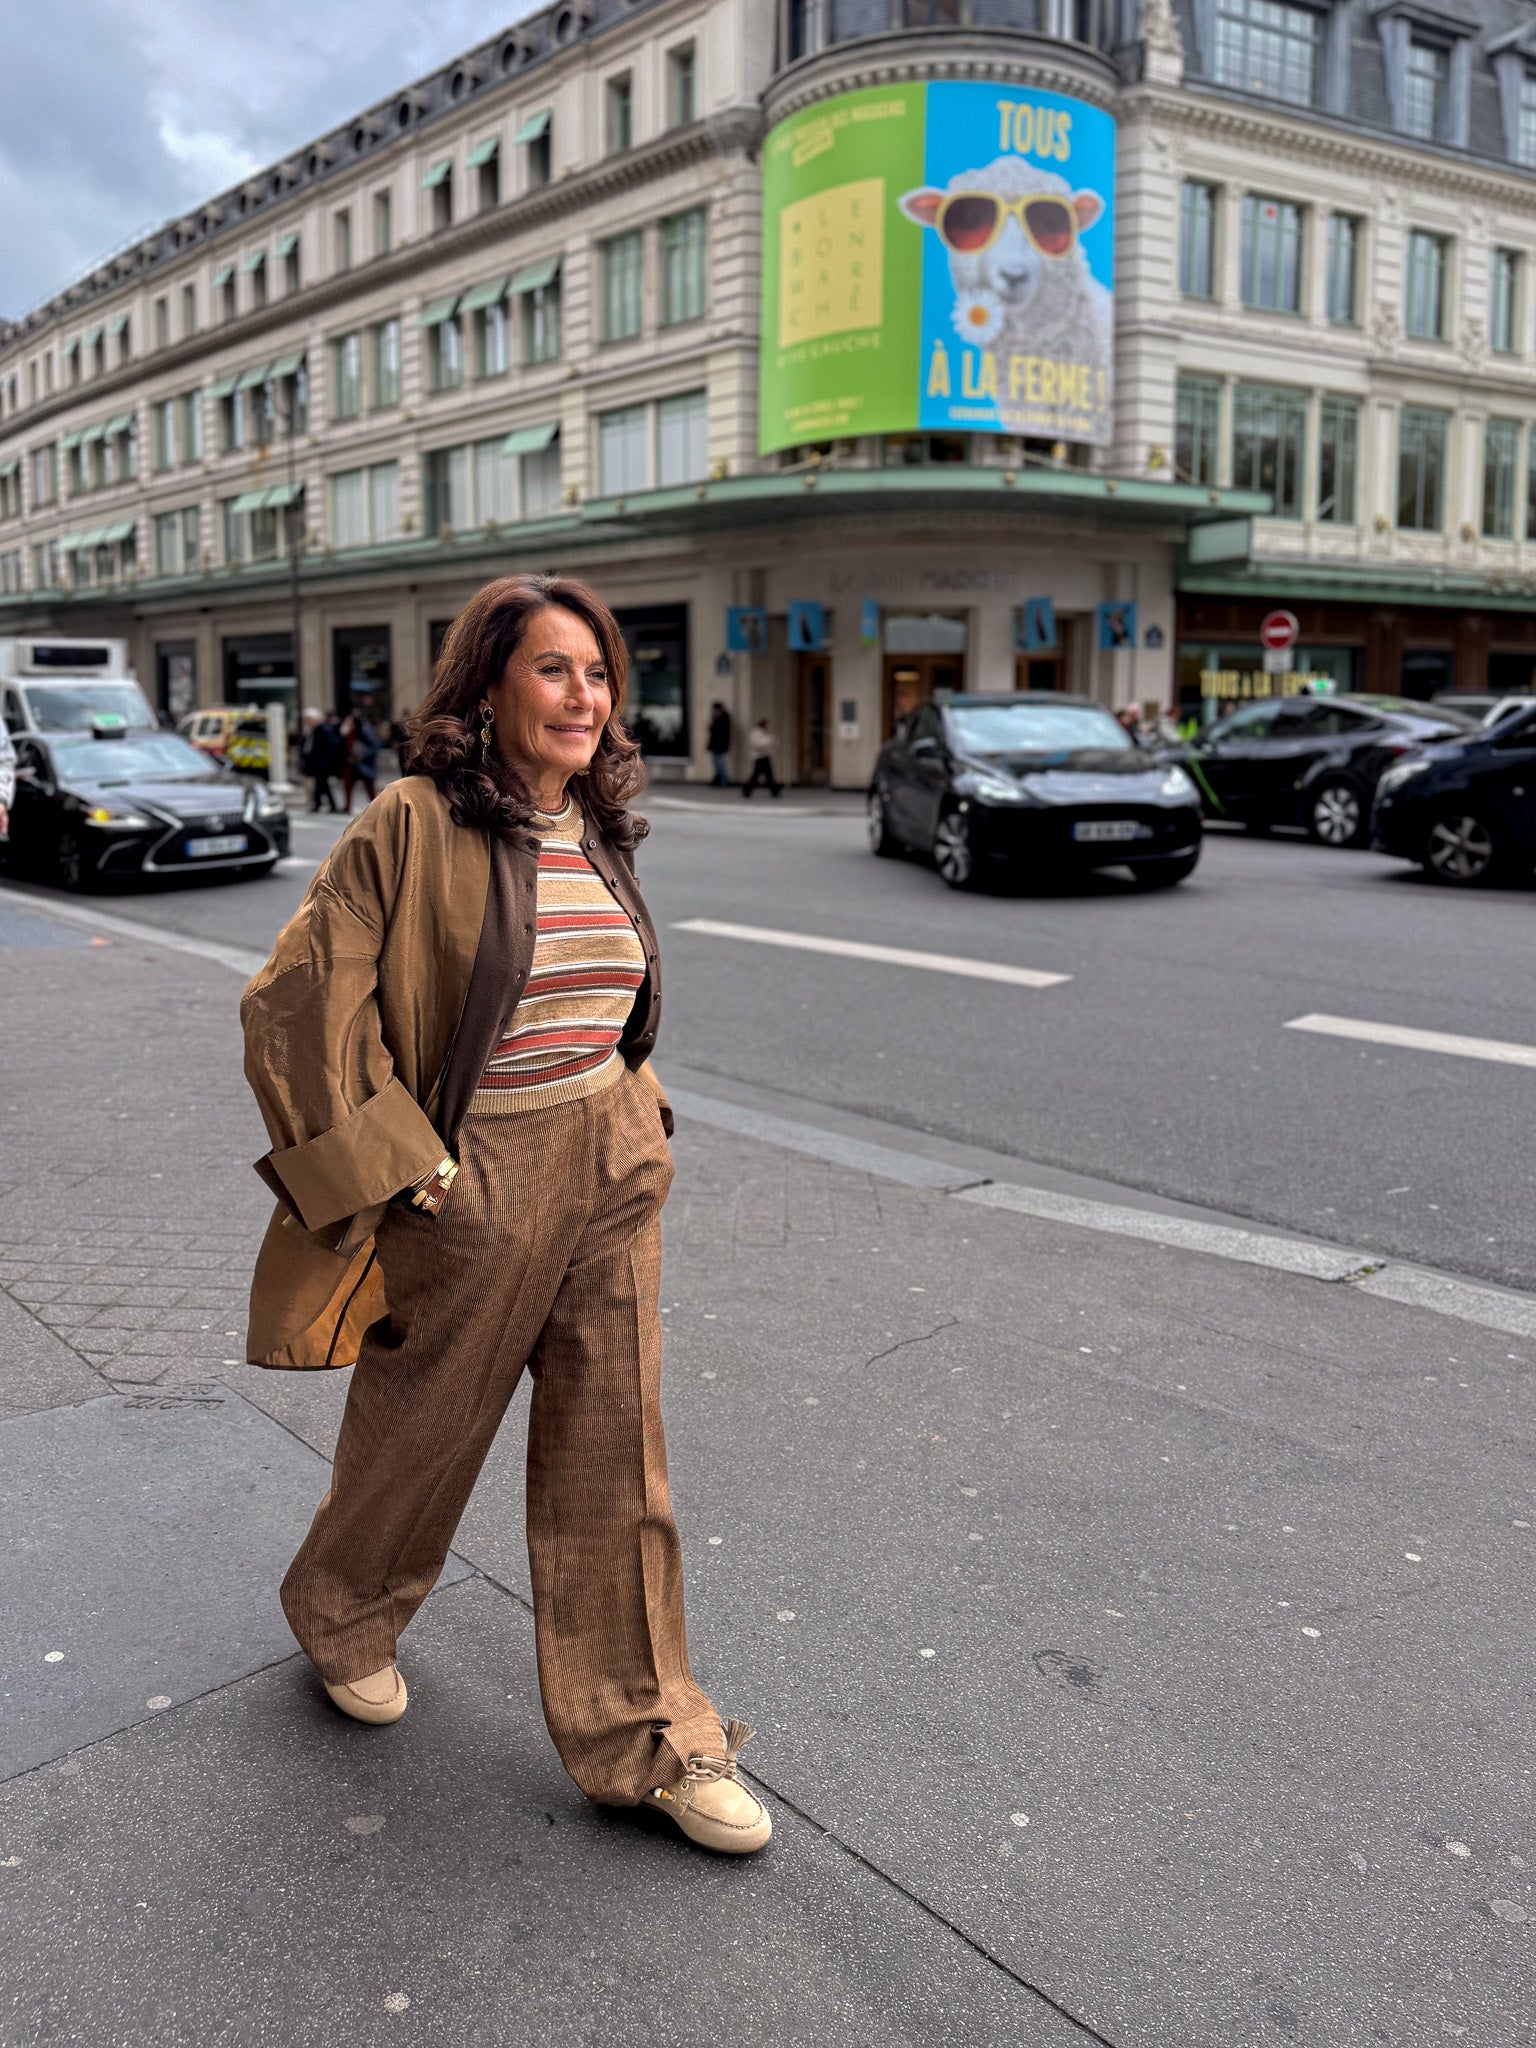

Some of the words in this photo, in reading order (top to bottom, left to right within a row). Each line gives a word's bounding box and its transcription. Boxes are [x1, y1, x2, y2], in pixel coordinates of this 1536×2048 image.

[997, 100, 1072, 162] TOUS
[927, 339, 951, 398] À
[961, 350, 999, 399] LA
[1008, 354, 1091, 412] FERME
